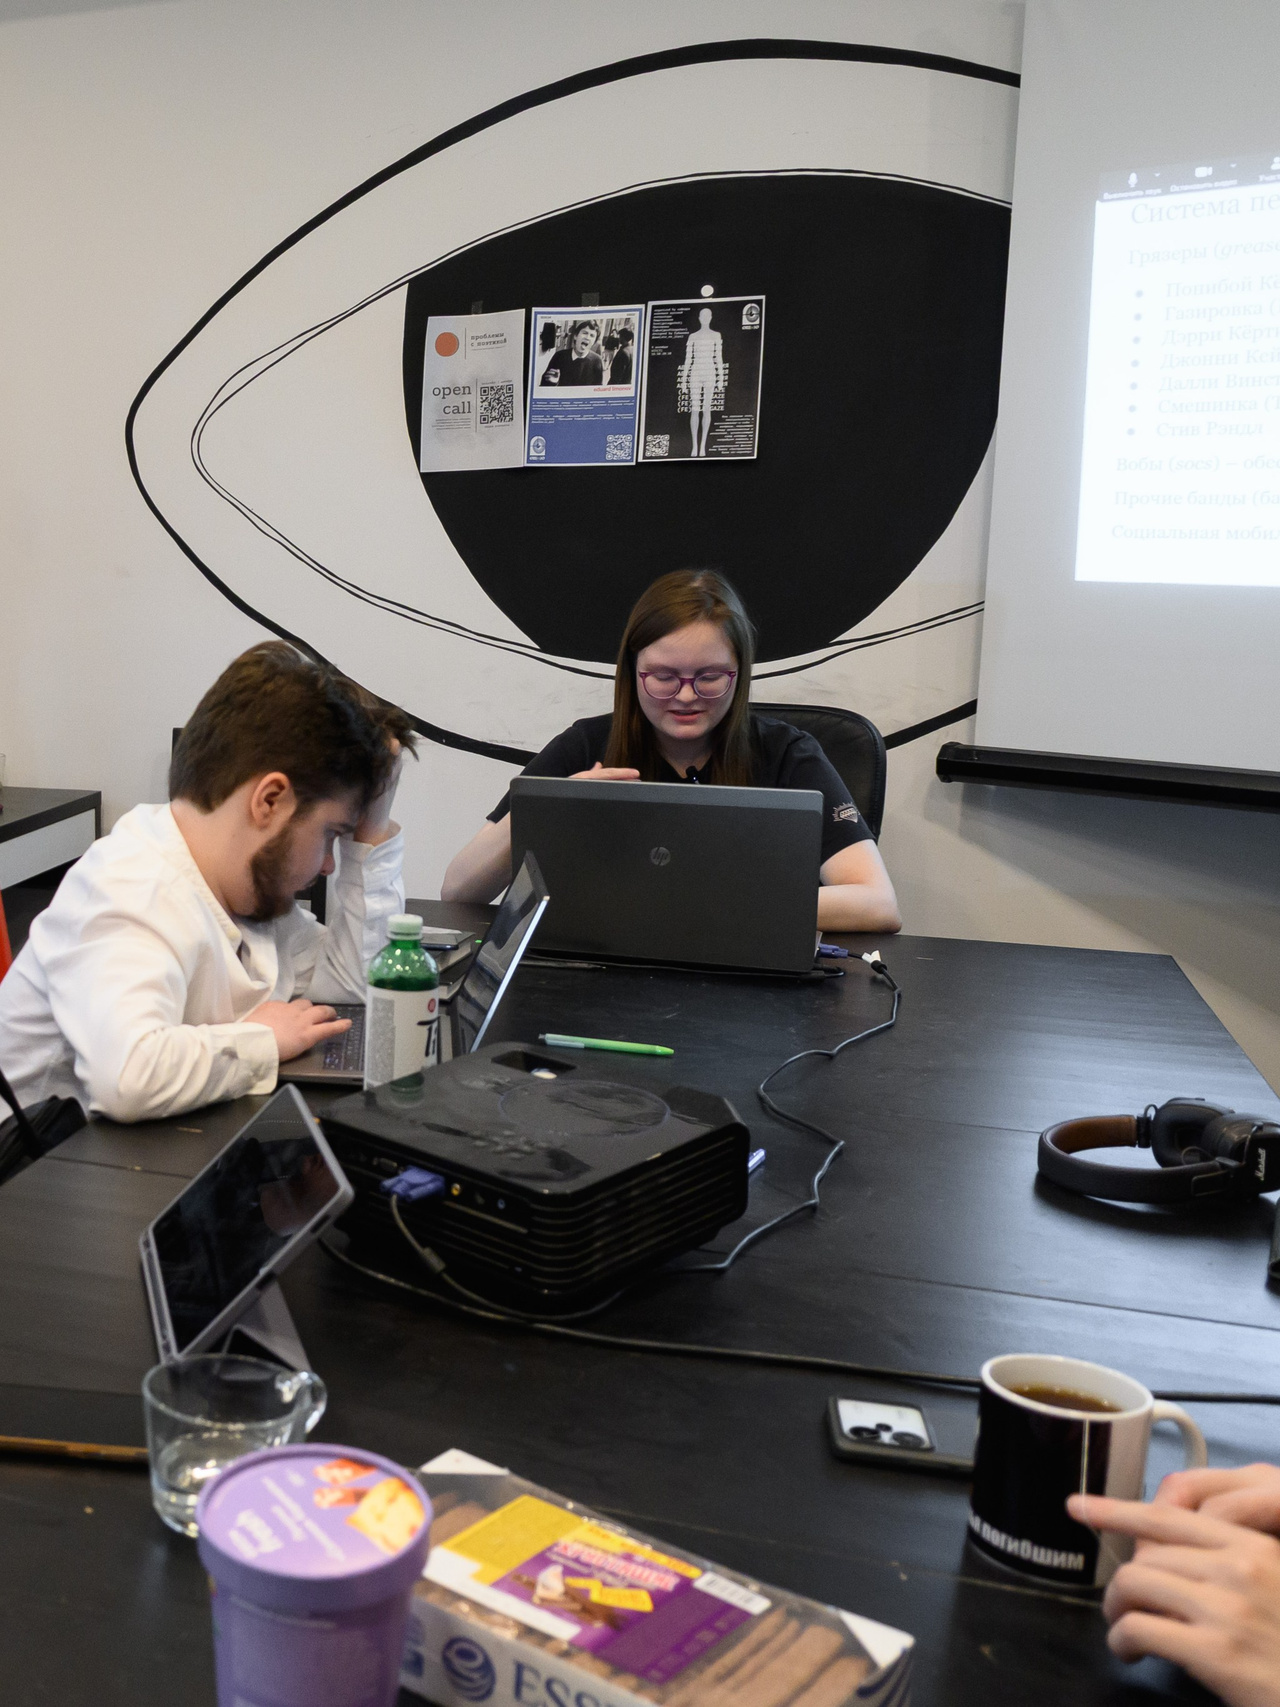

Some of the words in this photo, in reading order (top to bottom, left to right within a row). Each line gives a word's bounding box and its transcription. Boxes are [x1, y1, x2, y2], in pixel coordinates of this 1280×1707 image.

[1131, 197, 1240, 224] Система
[1128, 246, 1208, 268] Грязеры
[1164, 303, 1263, 322] Газировка
[1160, 329, 1223, 347] Дэрри
[1160, 352, 1239, 370] Джонни
[432, 385, 472, 399] open
[1158, 376, 1219, 393] Далли
[443, 401, 472, 415] call
[1158, 399, 1258, 413] Смешинка
[1156, 422, 1200, 437] Стив
[1206, 421, 1264, 437] Рэндл
[1116, 457, 1163, 471] Вобы
[1168, 456, 1220, 472] (socs)
[1114, 491, 1183, 509] Прочие
[1187, 490, 1246, 507] банды
[1111, 524, 1220, 541] Социальная
[982, 1521, 1085, 1571] погибшим
